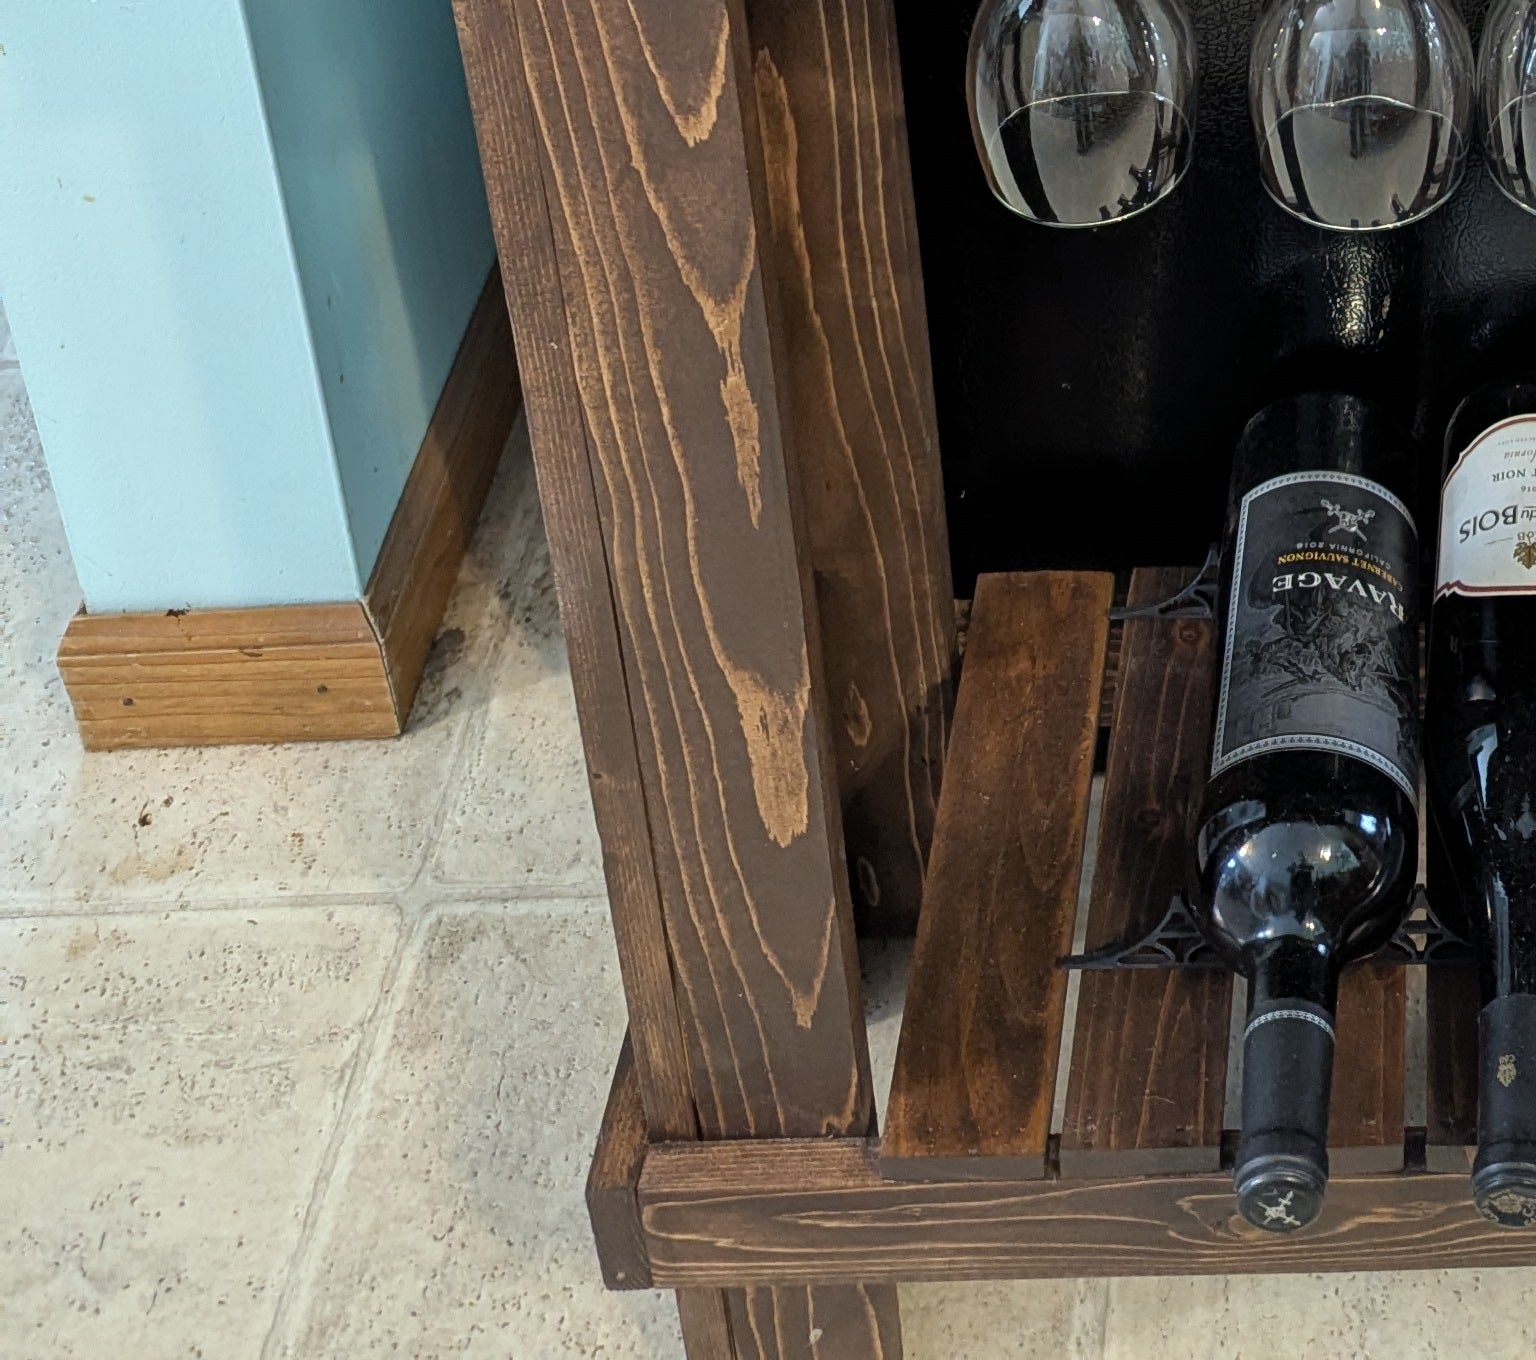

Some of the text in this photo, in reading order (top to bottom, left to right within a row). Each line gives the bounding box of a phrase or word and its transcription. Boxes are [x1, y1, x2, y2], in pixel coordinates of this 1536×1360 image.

[1492, 467, 1526, 482] NOIR
[1459, 504, 1518, 544] BOIS
[1277, 551, 1404, 592] CABERNET SAUVIGNON
[1329, 542, 1391, 570] CALIFORNIA
[1272, 571, 1405, 621] RAVAGE
